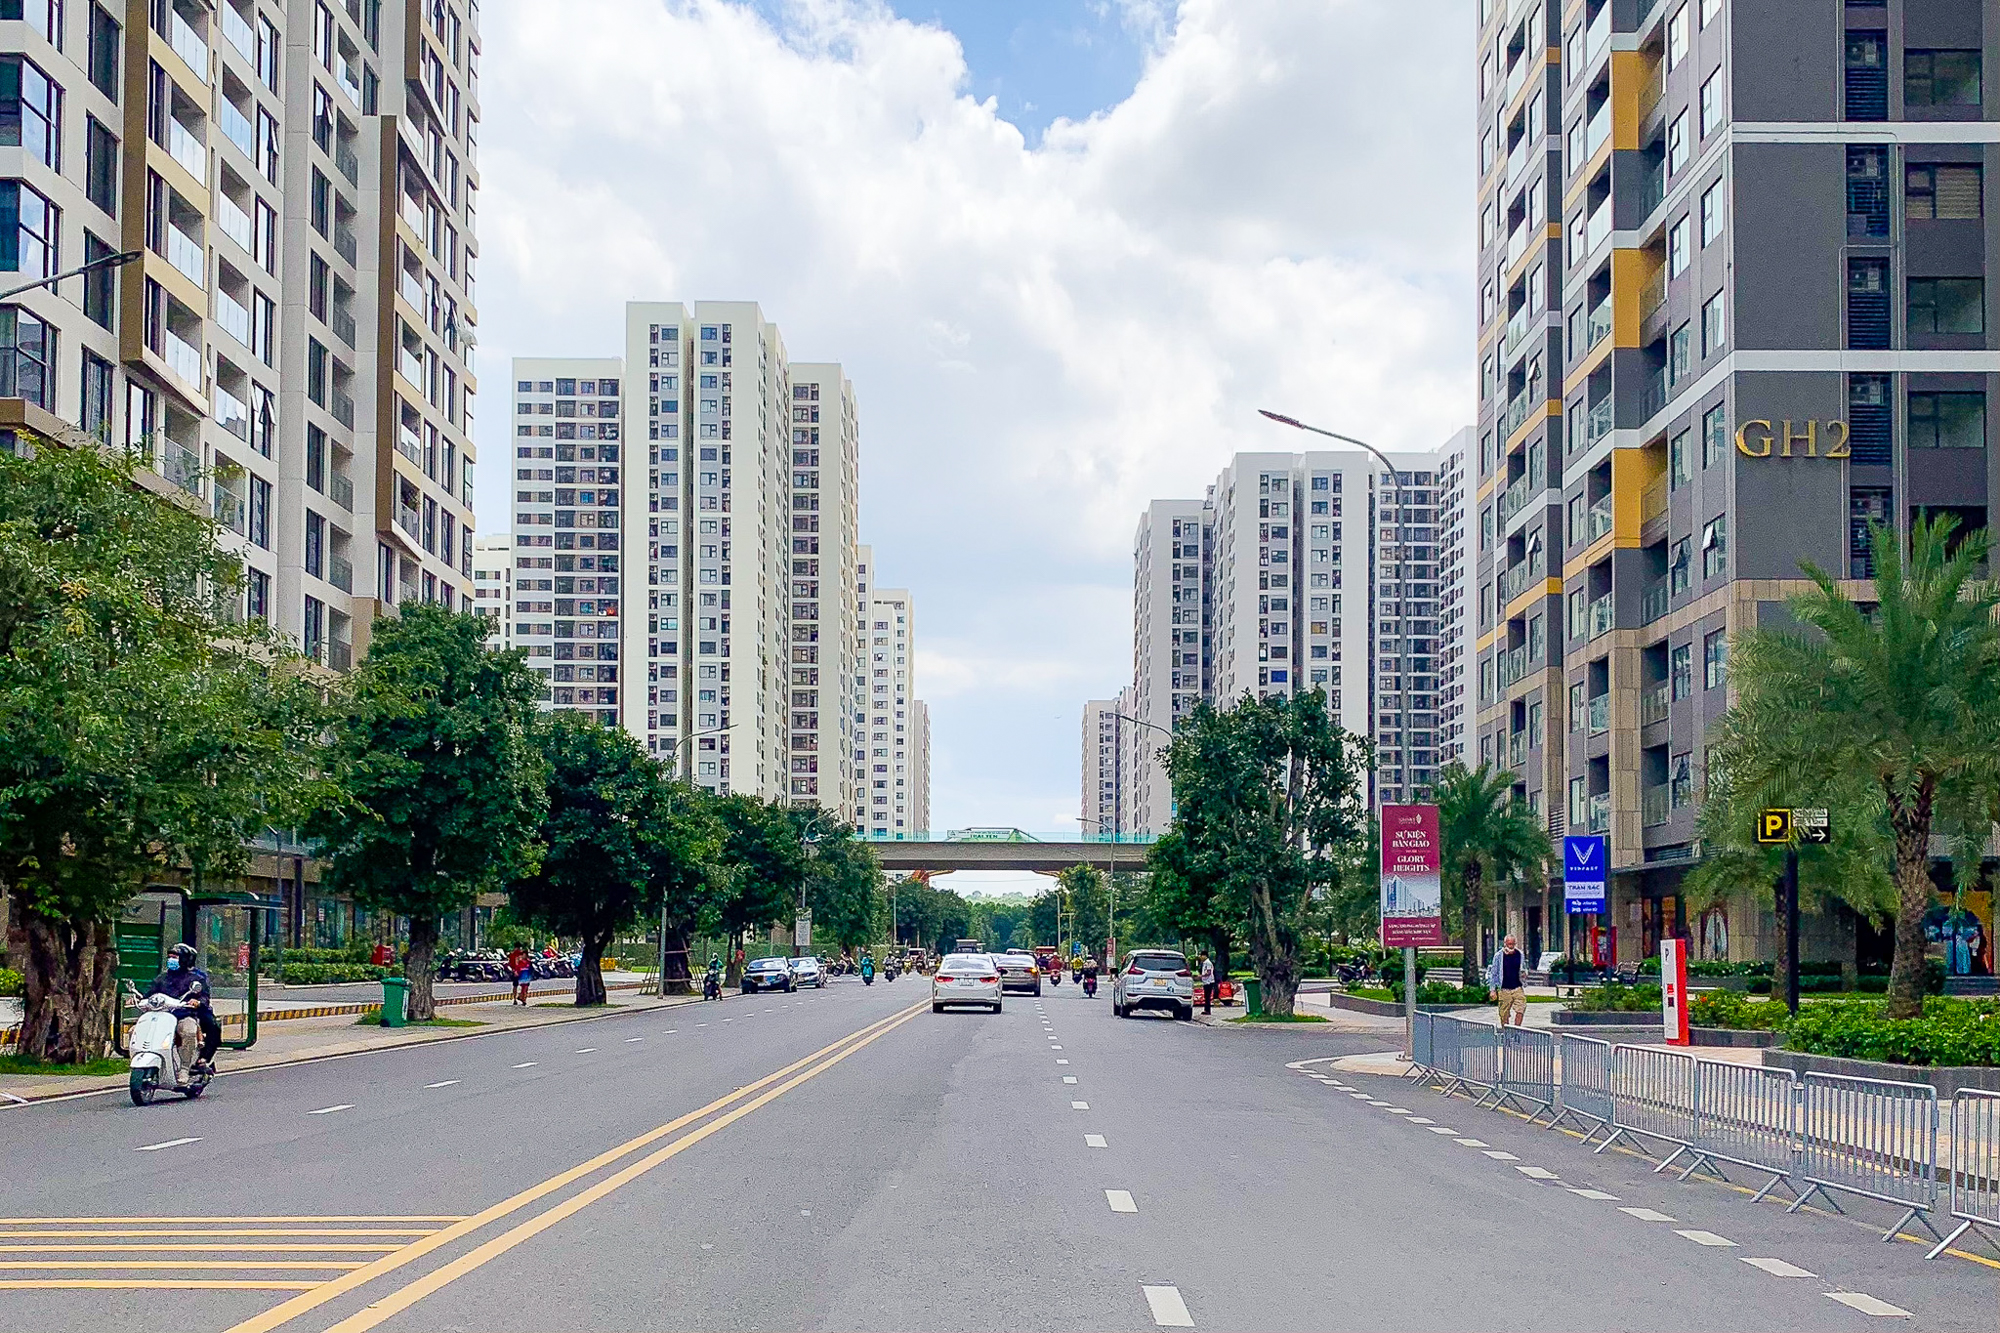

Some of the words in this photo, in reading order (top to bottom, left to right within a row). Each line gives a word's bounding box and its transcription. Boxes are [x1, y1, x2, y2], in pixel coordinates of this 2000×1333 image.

[1735, 419, 1851, 457] GH2
[1766, 815, 1782, 836] P
[1409, 839, 1430, 848] GIAO
[1397, 855, 1425, 863] GLORY
[1393, 864, 1430, 872] HEIGHTS
